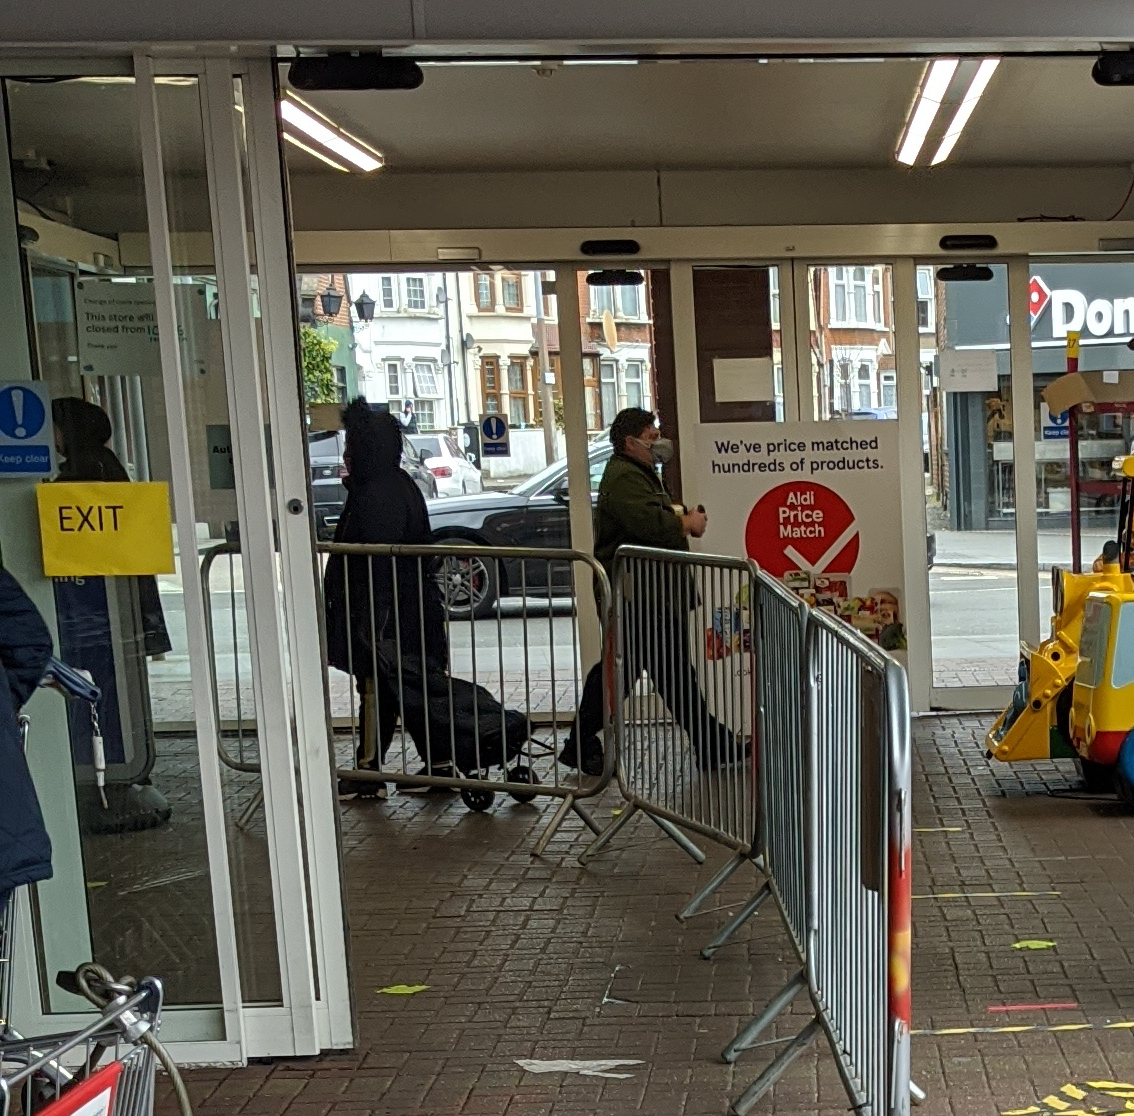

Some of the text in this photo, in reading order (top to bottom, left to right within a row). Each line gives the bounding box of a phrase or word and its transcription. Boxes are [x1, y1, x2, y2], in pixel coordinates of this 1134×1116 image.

[86, 324, 119, 334] closed
[715, 437, 878, 456] We've price matched
[25, 454, 48, 464] clear
[711, 457, 884, 475] hundreds of products.
[786, 490, 815, 506] Aldi
[58, 505, 124, 532] EXIT
[778, 507, 824, 524] Price
[779, 523, 825, 539] Match
